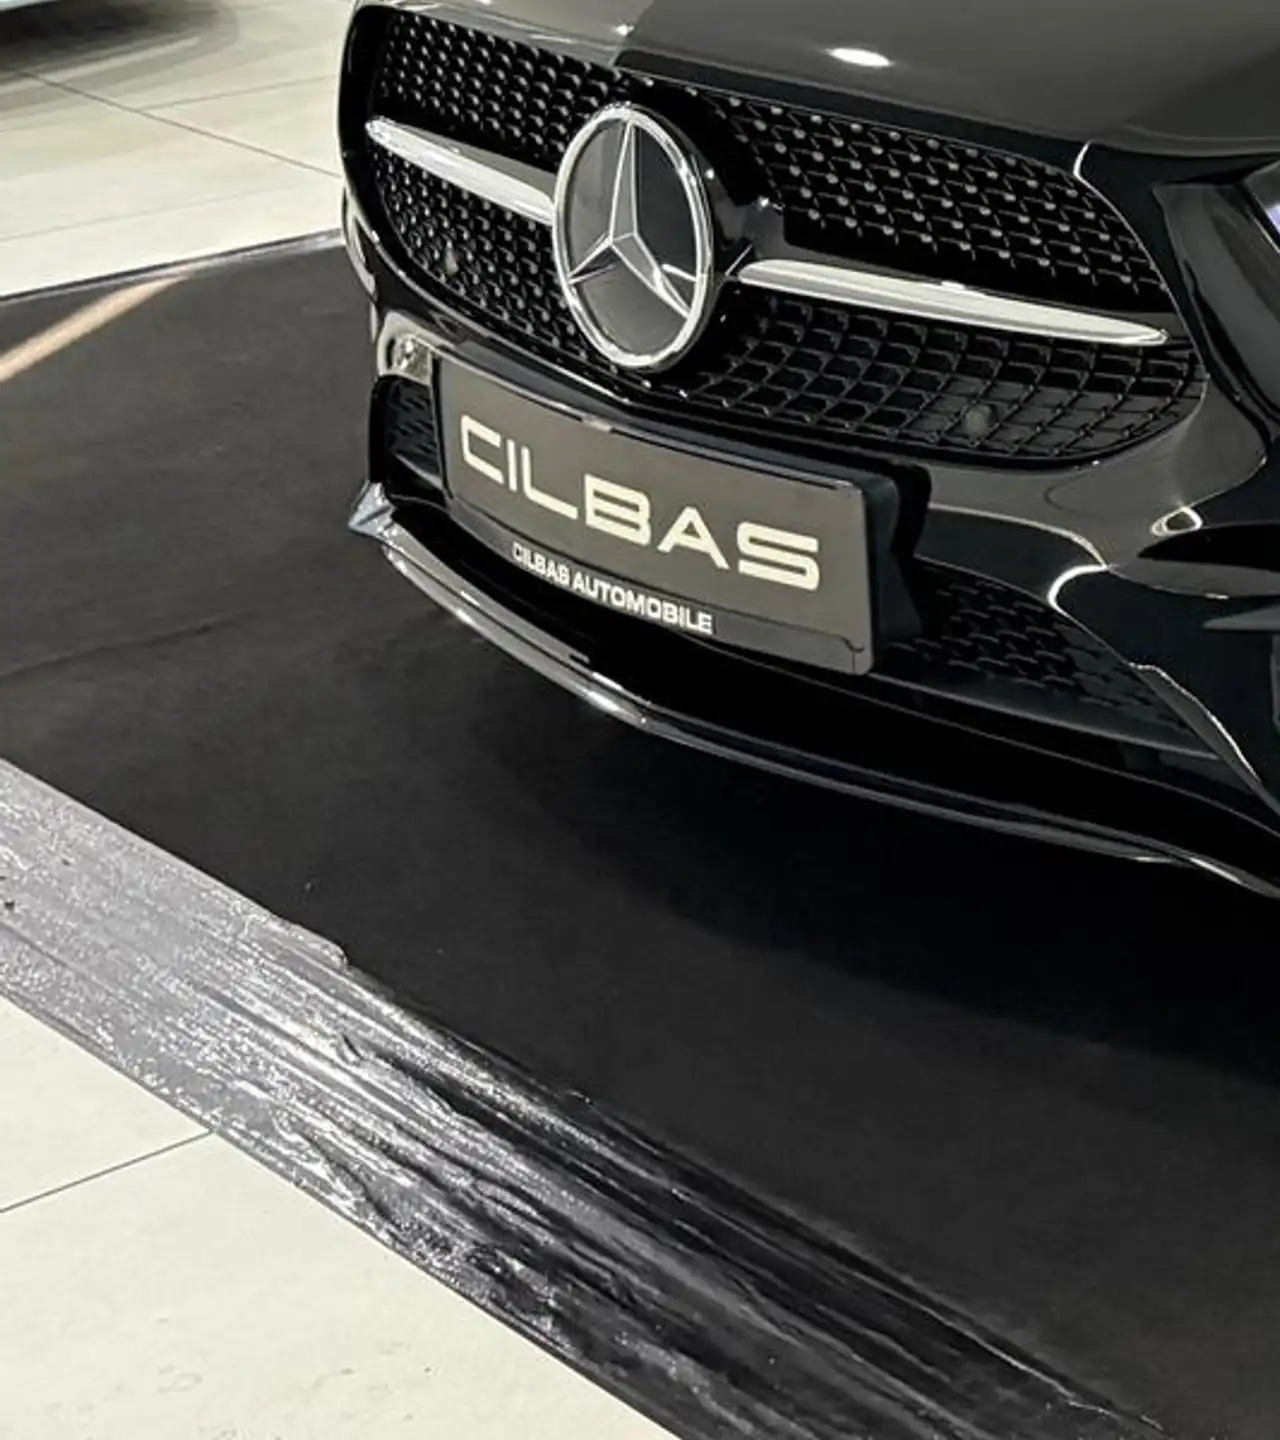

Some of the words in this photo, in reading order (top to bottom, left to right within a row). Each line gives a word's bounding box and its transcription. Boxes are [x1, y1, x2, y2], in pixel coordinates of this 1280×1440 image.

[460, 415, 821, 593] CILBAS
[511, 541, 571, 589] CILBAS
[571, 571, 714, 636] AUTOMOBILE
